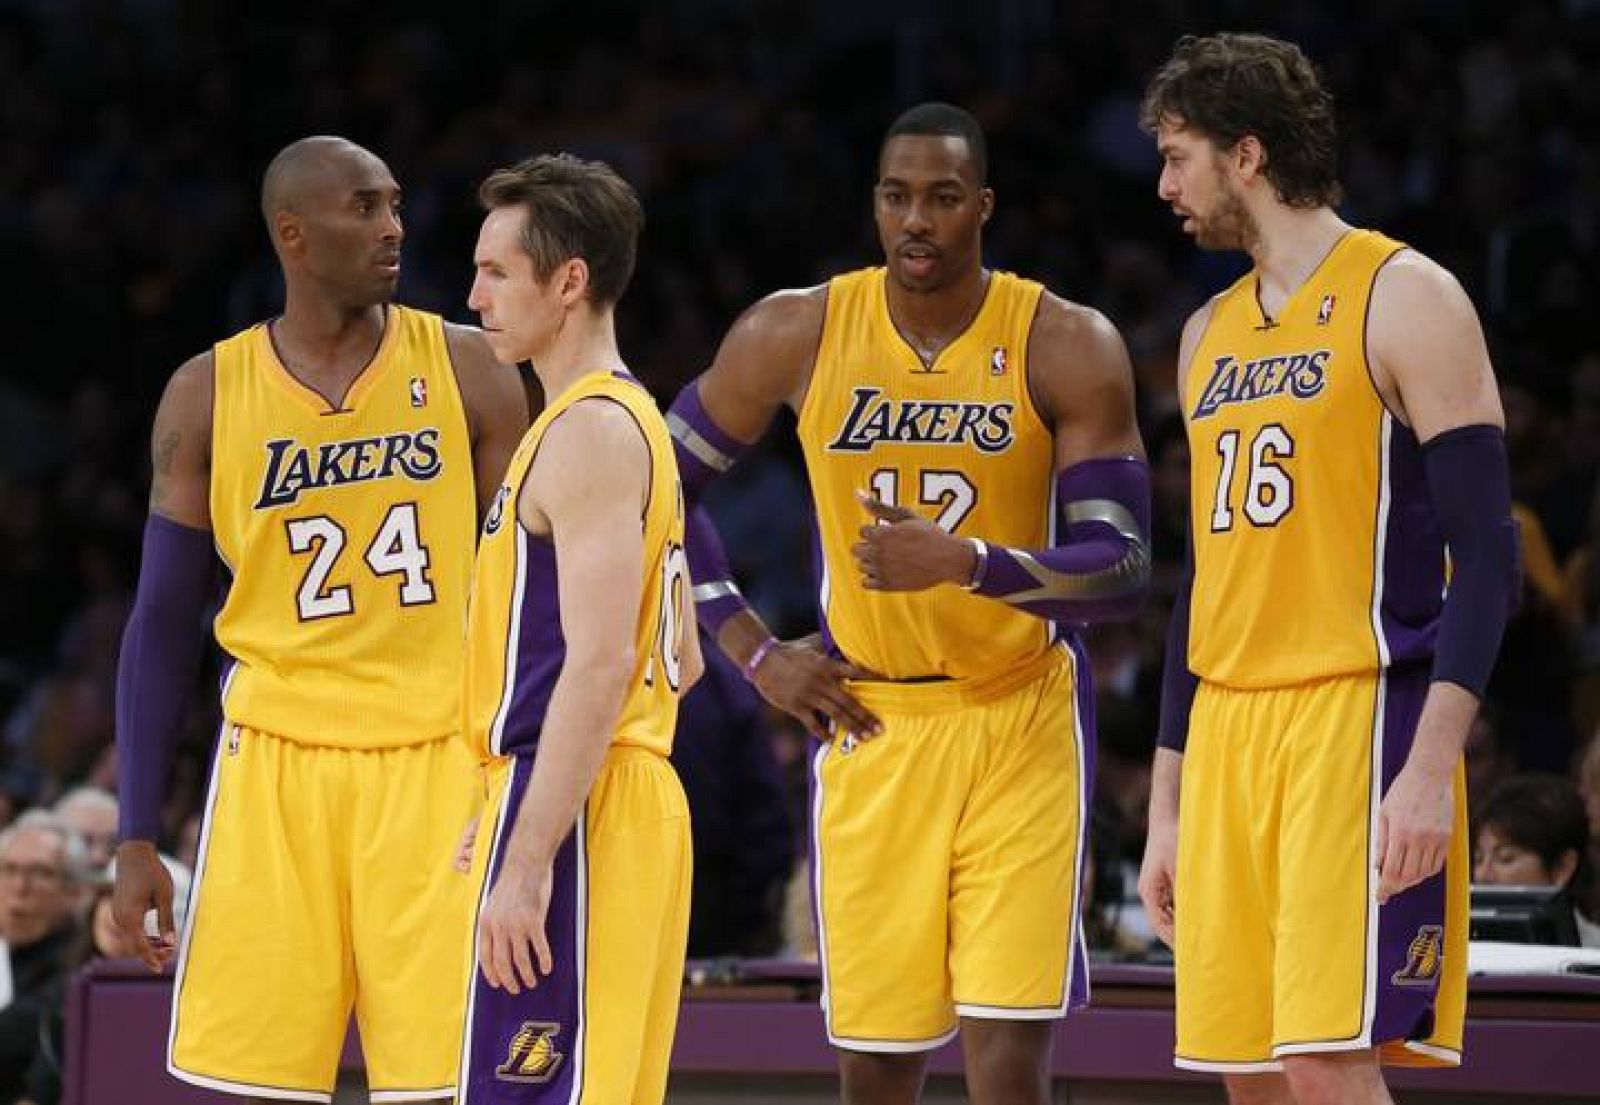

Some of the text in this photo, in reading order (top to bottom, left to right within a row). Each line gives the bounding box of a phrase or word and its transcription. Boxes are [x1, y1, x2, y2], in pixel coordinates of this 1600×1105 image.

[827, 387, 1015, 452] LAKERS
[1192, 350, 1333, 421] LAKERS
[252, 428, 443, 510] LAKERS
[1210, 422, 1295, 533] 16
[284, 502, 437, 622] 24
